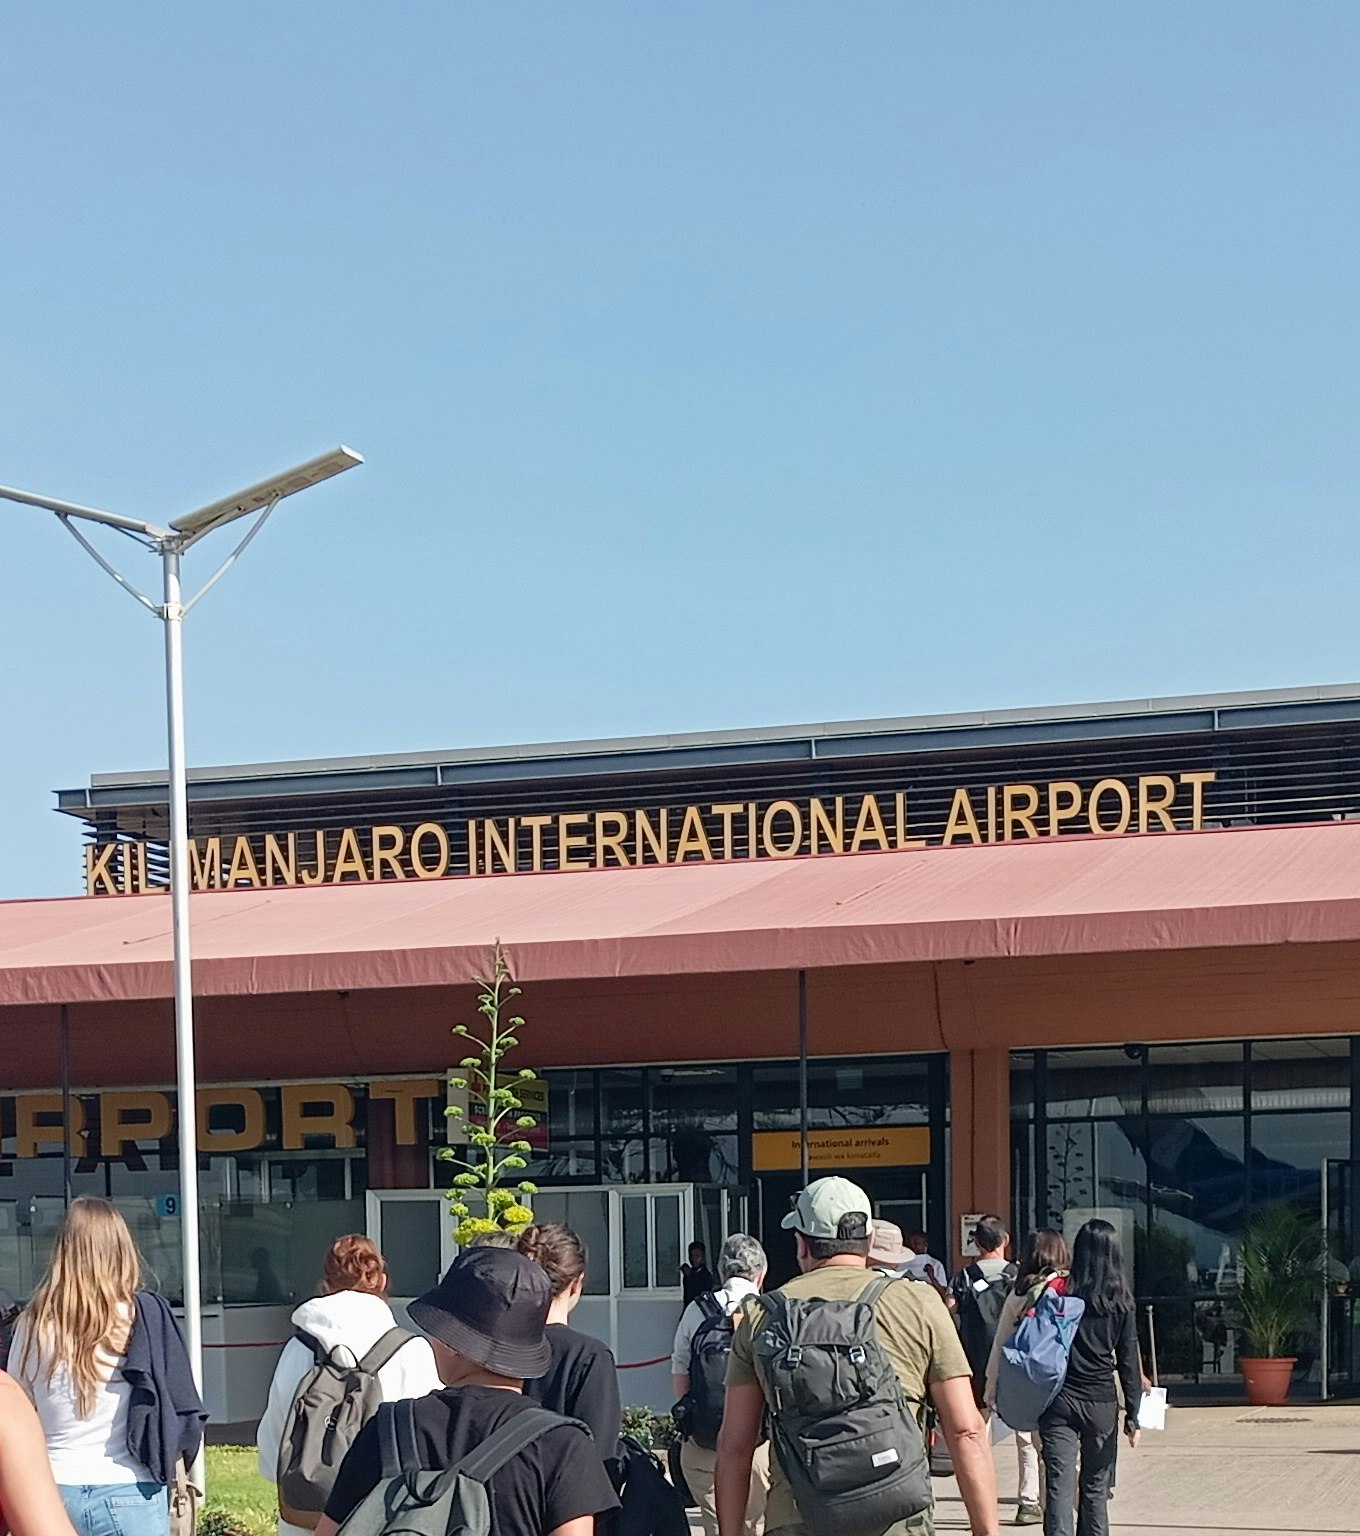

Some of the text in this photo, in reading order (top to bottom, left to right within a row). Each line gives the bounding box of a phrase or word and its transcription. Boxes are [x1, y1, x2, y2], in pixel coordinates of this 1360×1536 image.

[85, 771, 1216, 896] KILMANJARO INTERNATIONAL AIRPORT
[854, 1136, 890, 1147] arrivals
[165, 1197, 176, 1214] 9
